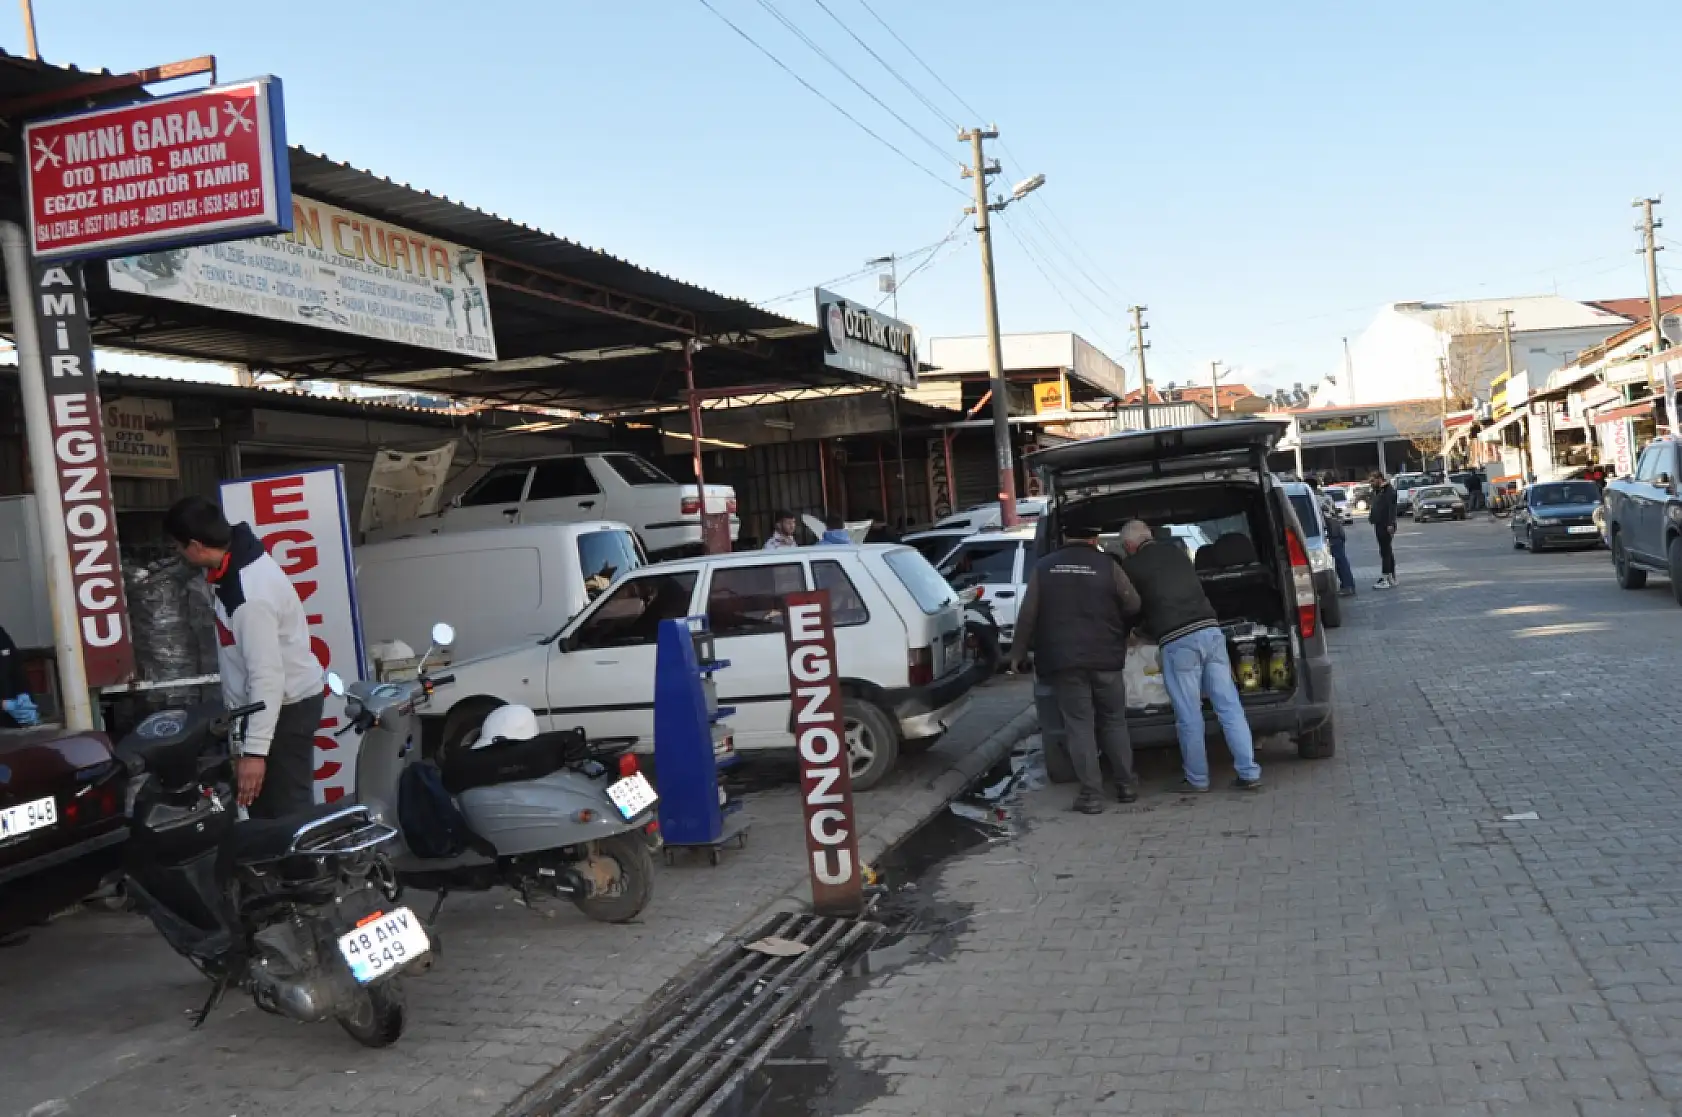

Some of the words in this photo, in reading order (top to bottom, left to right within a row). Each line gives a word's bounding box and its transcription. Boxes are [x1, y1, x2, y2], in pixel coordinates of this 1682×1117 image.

[132, 106, 219, 151] GARAJ
[62, 166, 94, 188] OTO
[170, 142, 227, 169] BAKIM
[44, 190, 98, 216] EGZOZ
[103, 171, 190, 205] RADYATÖR
[54, 393, 123, 648] EGZOZCU
[788, 603, 853, 886] EGZOZCU
[349, 934, 372, 955] 48
[375, 912, 409, 943] AHV
[368, 940, 405, 969] 549
